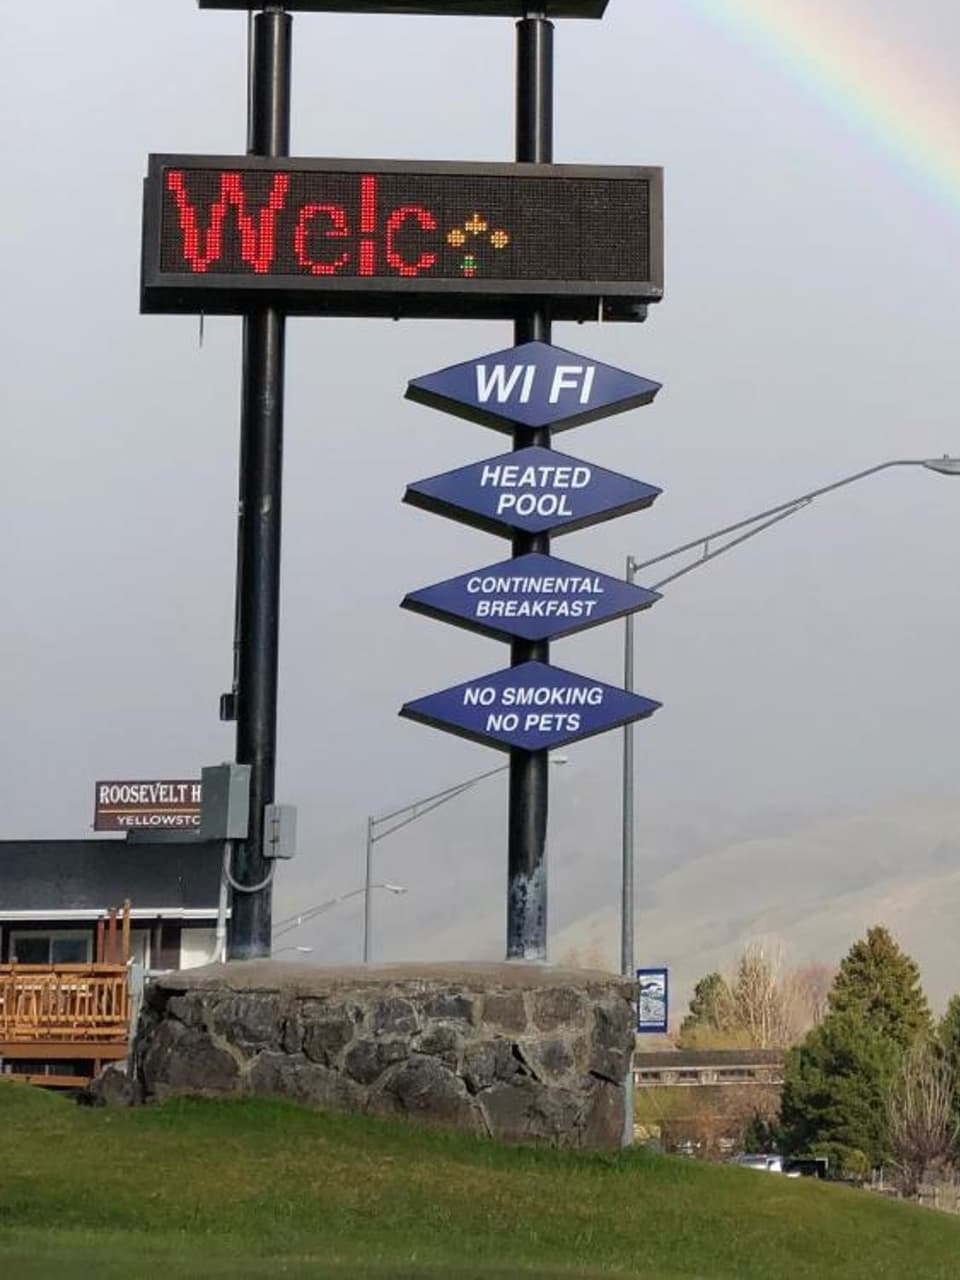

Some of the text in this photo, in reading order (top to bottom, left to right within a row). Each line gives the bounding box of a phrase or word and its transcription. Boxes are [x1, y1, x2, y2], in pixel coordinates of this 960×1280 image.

[165, 169, 437, 275] Welc
[475, 364, 596, 404] WI FI
[480, 465, 591, 489] HEATED
[496, 493, 573, 516] POOL
[466, 577, 604, 593] CONTINENTAL
[475, 600, 597, 617] BREAKFAST
[463, 687, 603, 706] NO SMOKING
[486, 713, 581, 732] NO PETS
[99, 782, 188, 804] ROOSEVELT
